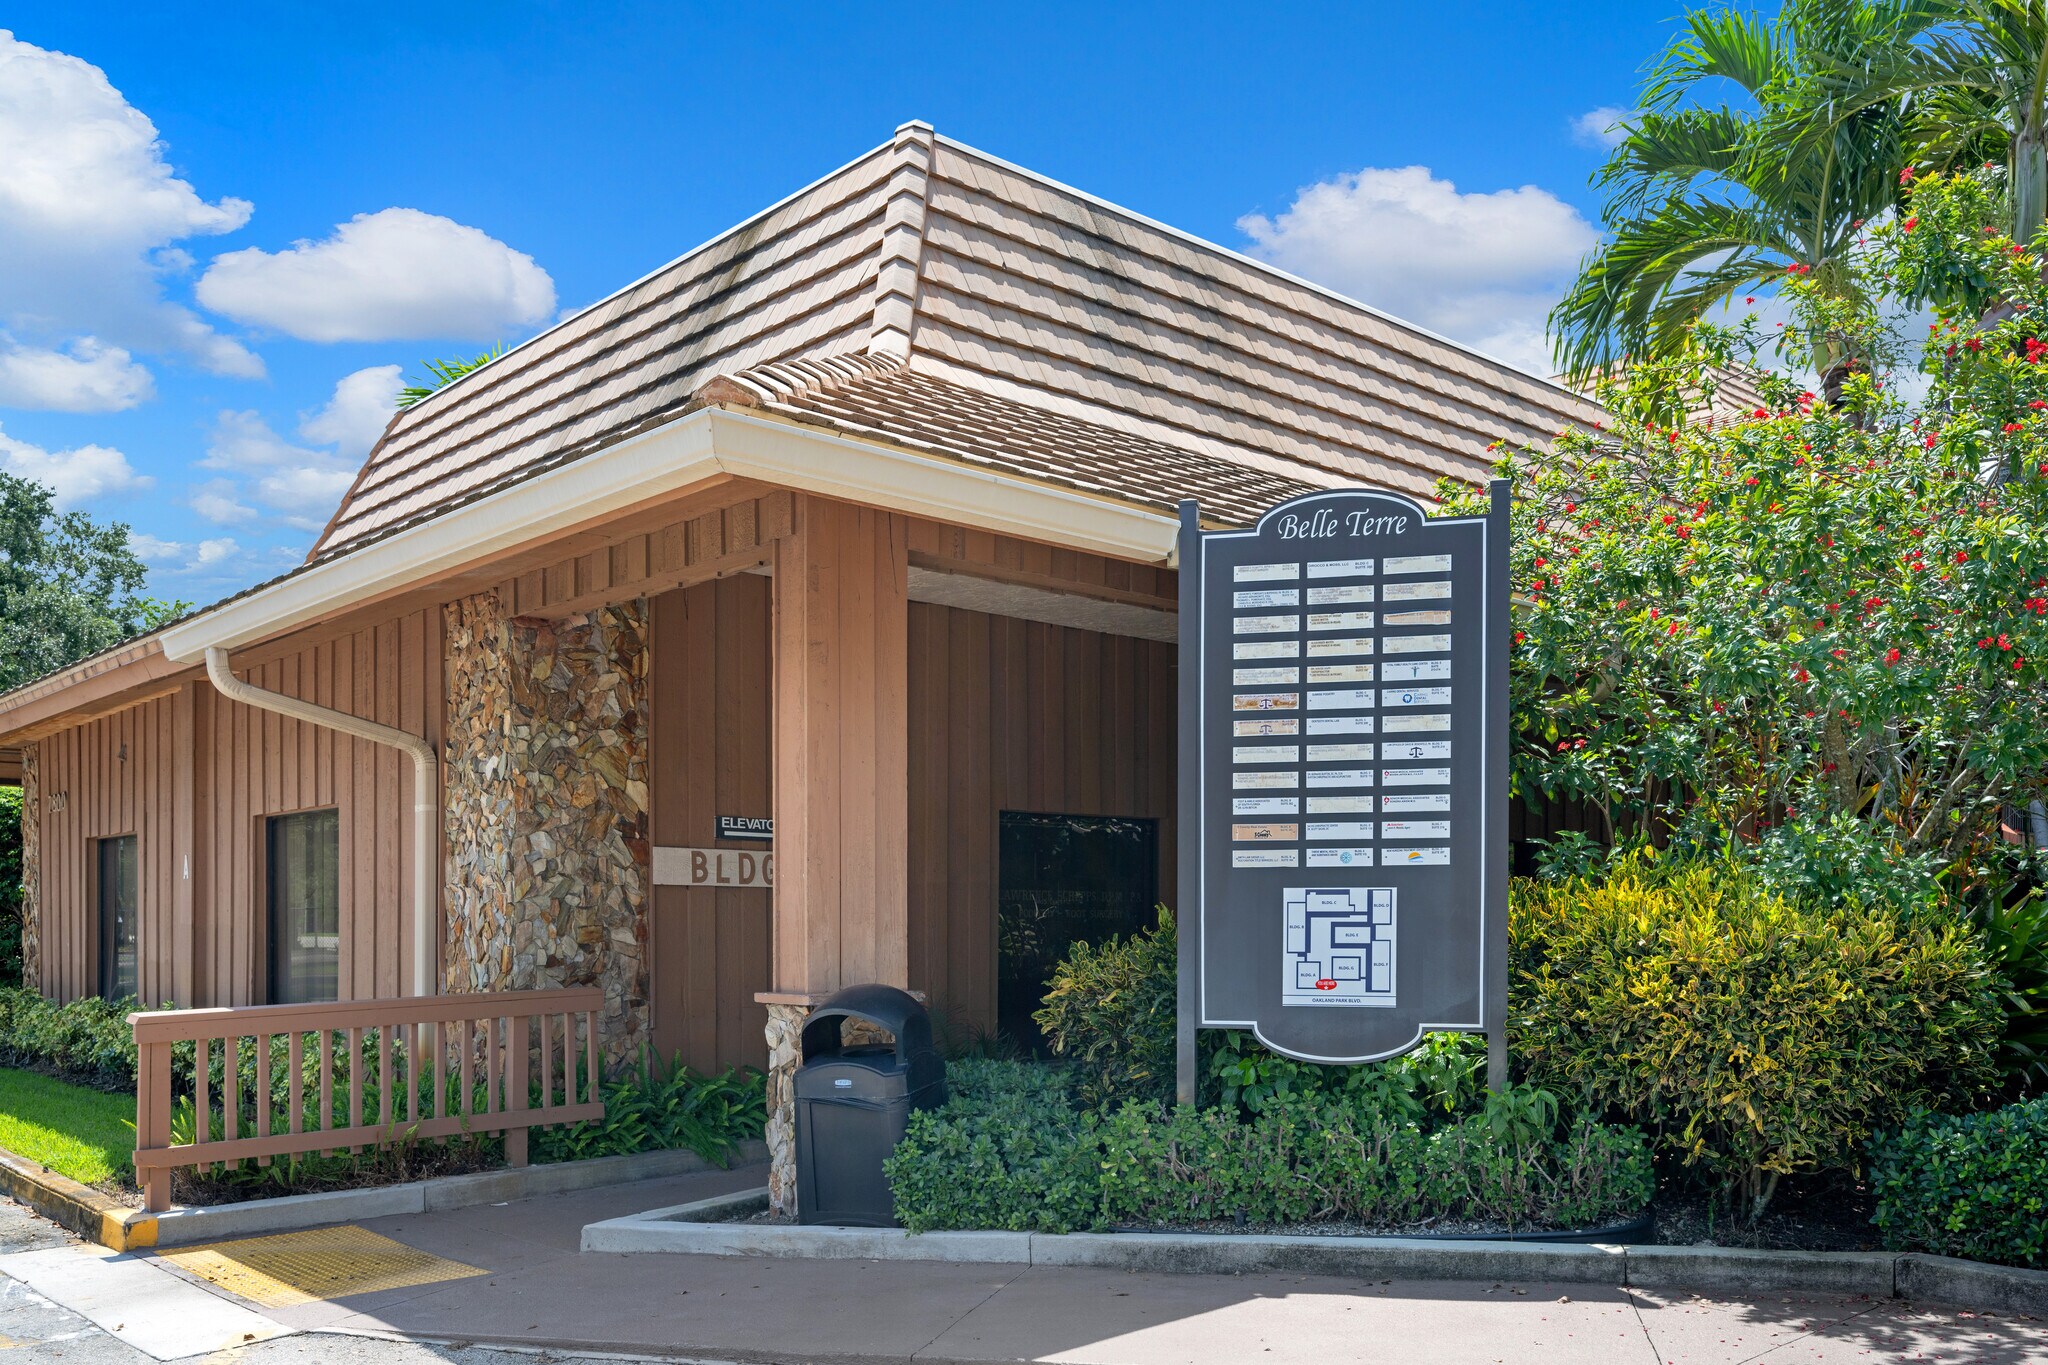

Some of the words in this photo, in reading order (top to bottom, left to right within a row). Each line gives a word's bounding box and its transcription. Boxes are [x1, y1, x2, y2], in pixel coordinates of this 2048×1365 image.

[1278, 509, 1338, 540] Belle
[1346, 508, 1407, 537] Terre
[183, 854, 189, 880] A
[691, 850, 773, 885] BLDG
